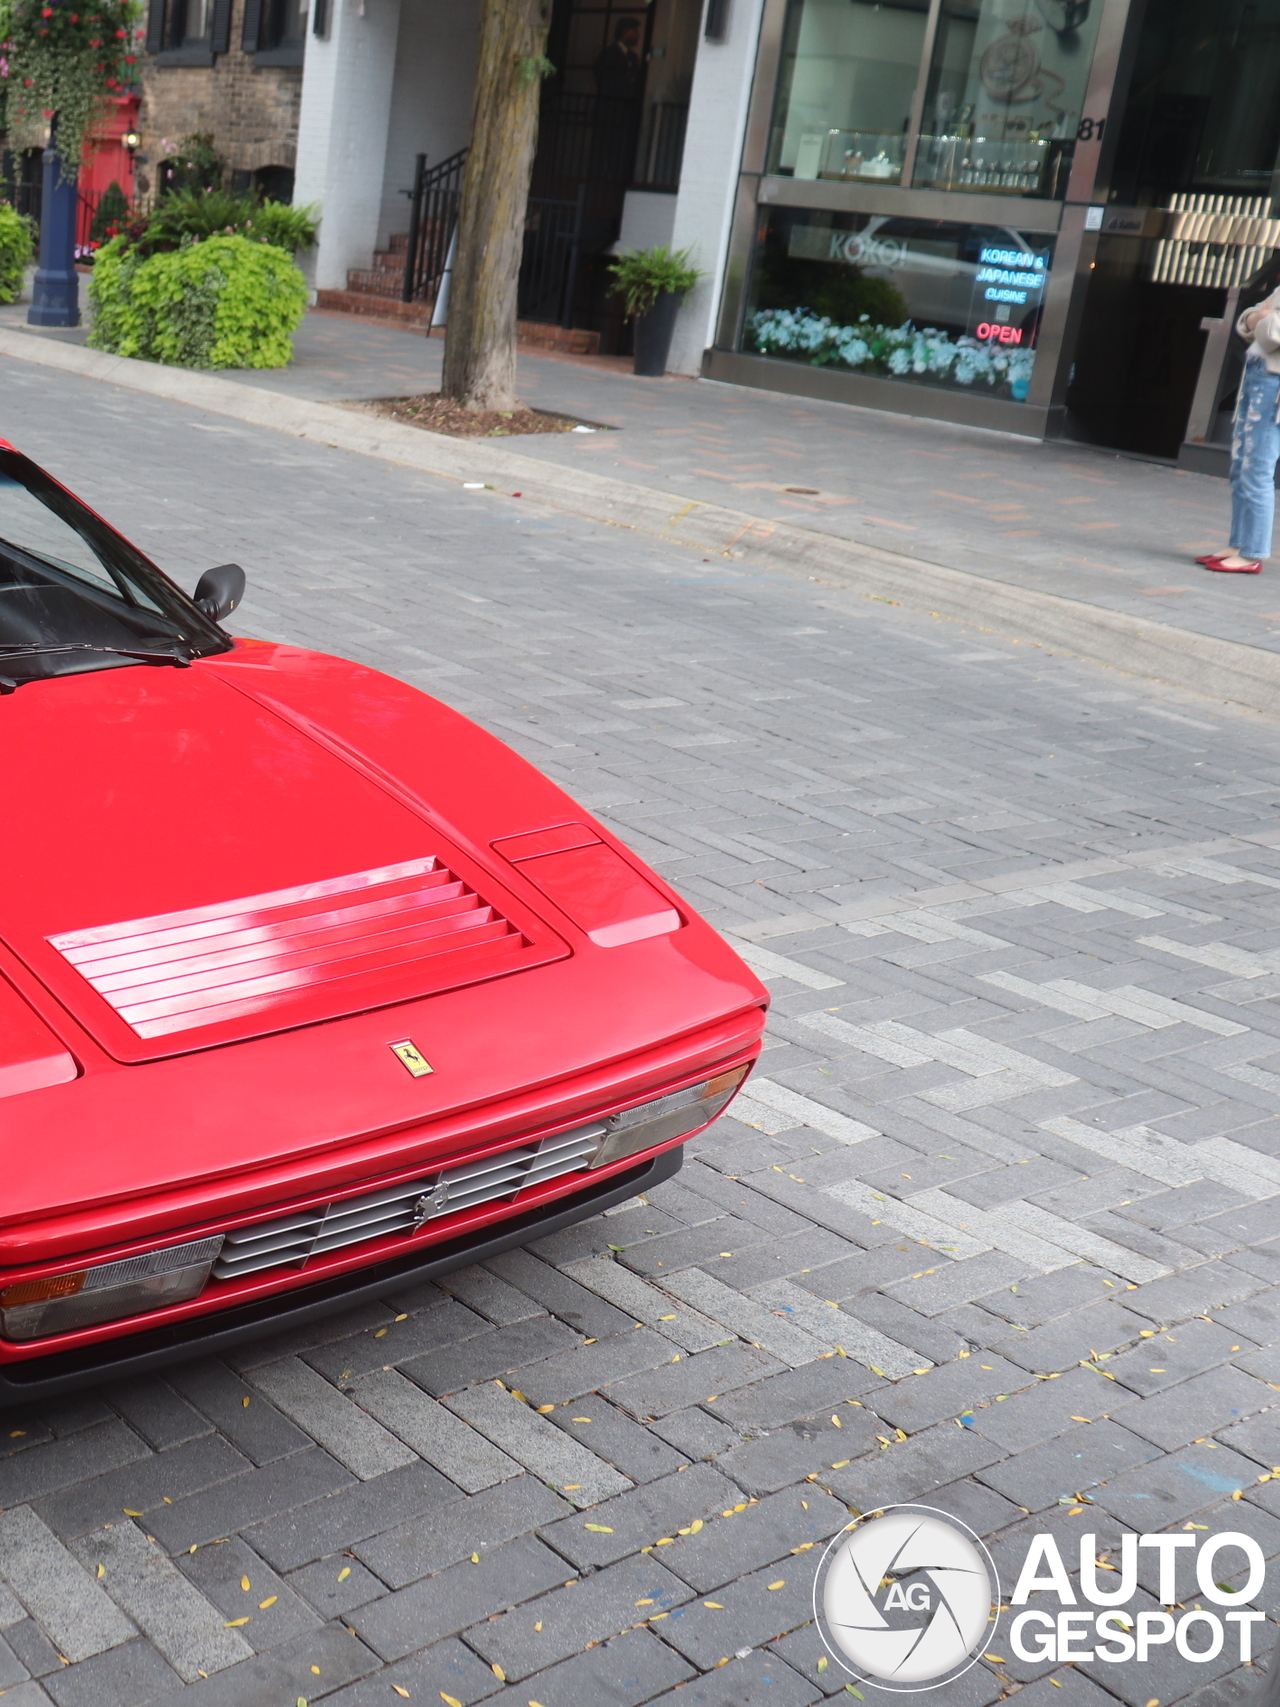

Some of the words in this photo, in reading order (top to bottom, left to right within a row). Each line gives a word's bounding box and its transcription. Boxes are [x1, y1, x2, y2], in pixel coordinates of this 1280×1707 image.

[1078, 117, 1106, 141] 81
[981, 248, 1034, 269] KOREAN
[1034, 255, 1045, 269] &
[976, 267, 1044, 289] JAPANESE
[984, 287, 1028, 305] CUISINE
[976, 322, 1023, 344] OPEN
